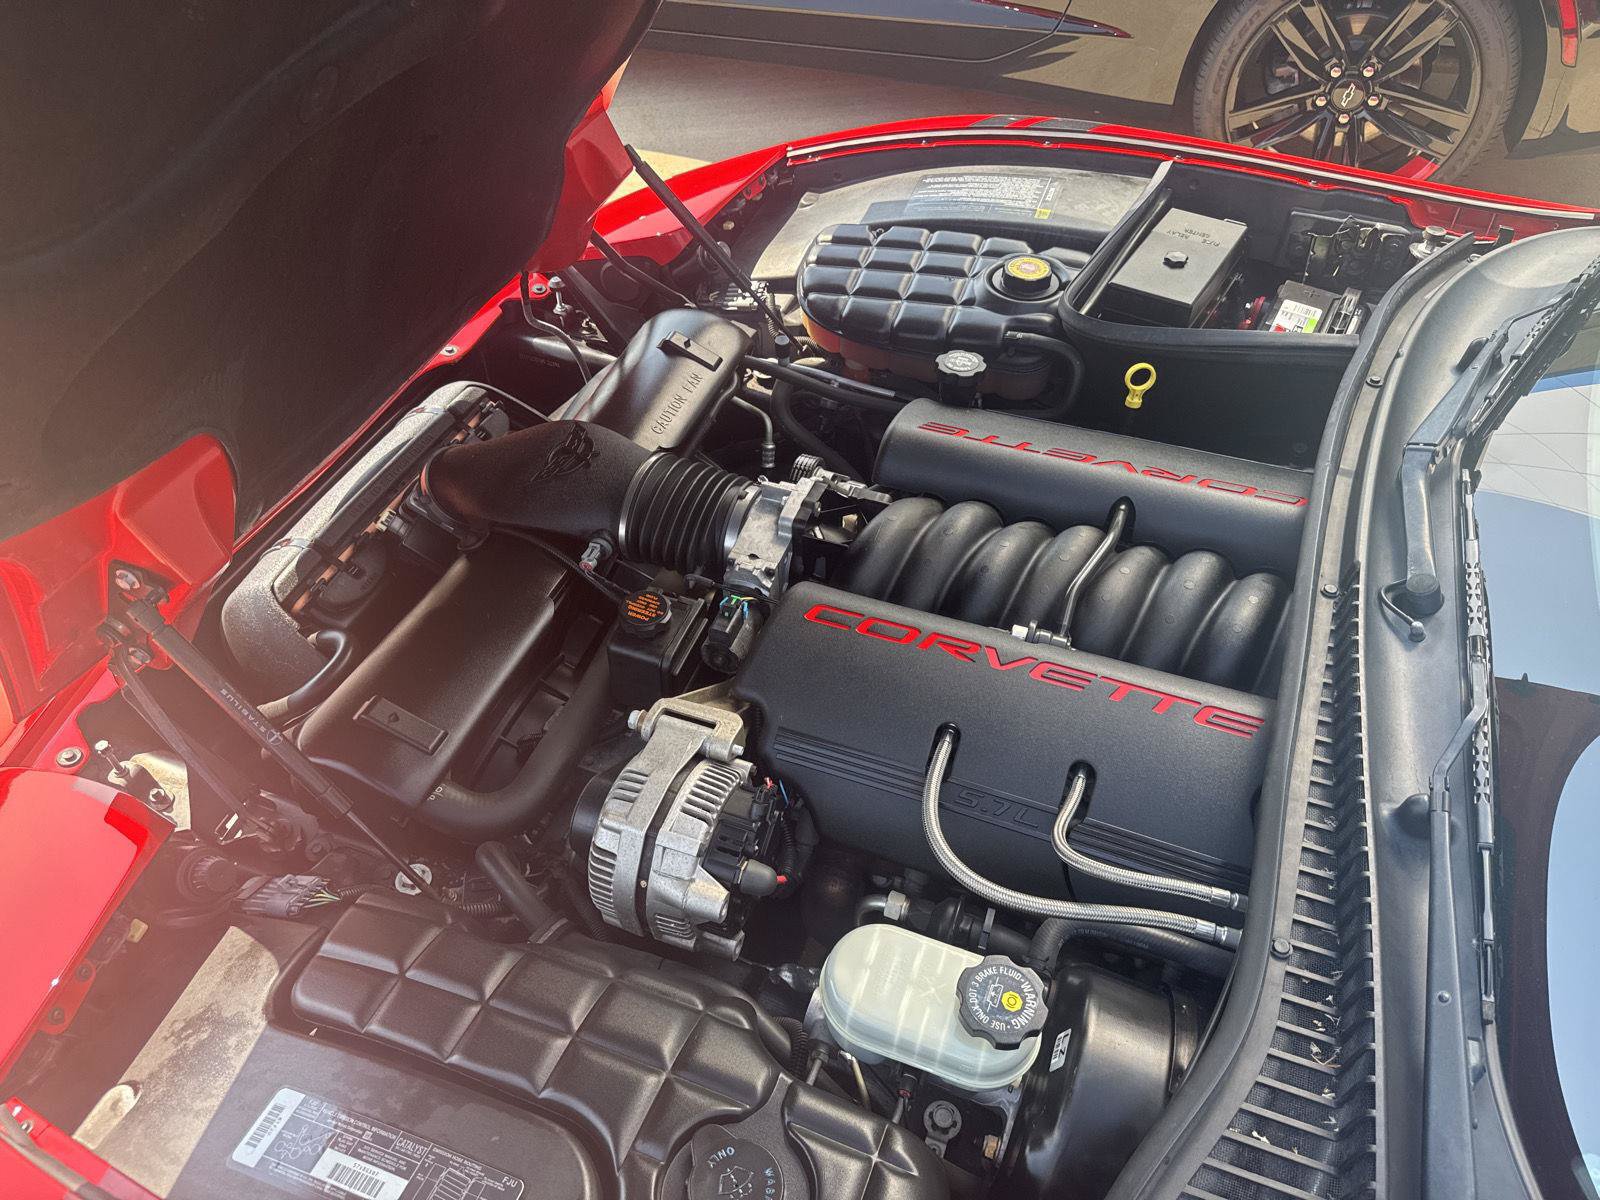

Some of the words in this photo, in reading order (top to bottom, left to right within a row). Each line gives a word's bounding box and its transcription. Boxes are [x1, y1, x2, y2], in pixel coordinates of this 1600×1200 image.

[651, 393, 687, 435] CAUTION
[682, 372, 703, 394] FAN
[917, 421, 1308, 508] CORVETTE
[803, 603, 1265, 739] CORVETTE
[220, 688, 267, 733] STABILUS
[953, 790, 1040, 829] 5.7L
[976, 966, 998, 982] BRAKE
[999, 966, 1022, 982] FLUID
[968, 987, 978, 1004] DOT
[1011, 981, 1037, 1029] WARNING
[971, 1005, 989, 1024] ONLY
[990, 1020, 1006, 1031] USE
[396, 1137, 427, 1156] CATALYST
[706, 1146, 736, 1169] ONLY
[502, 1176, 518, 1188] FJU
